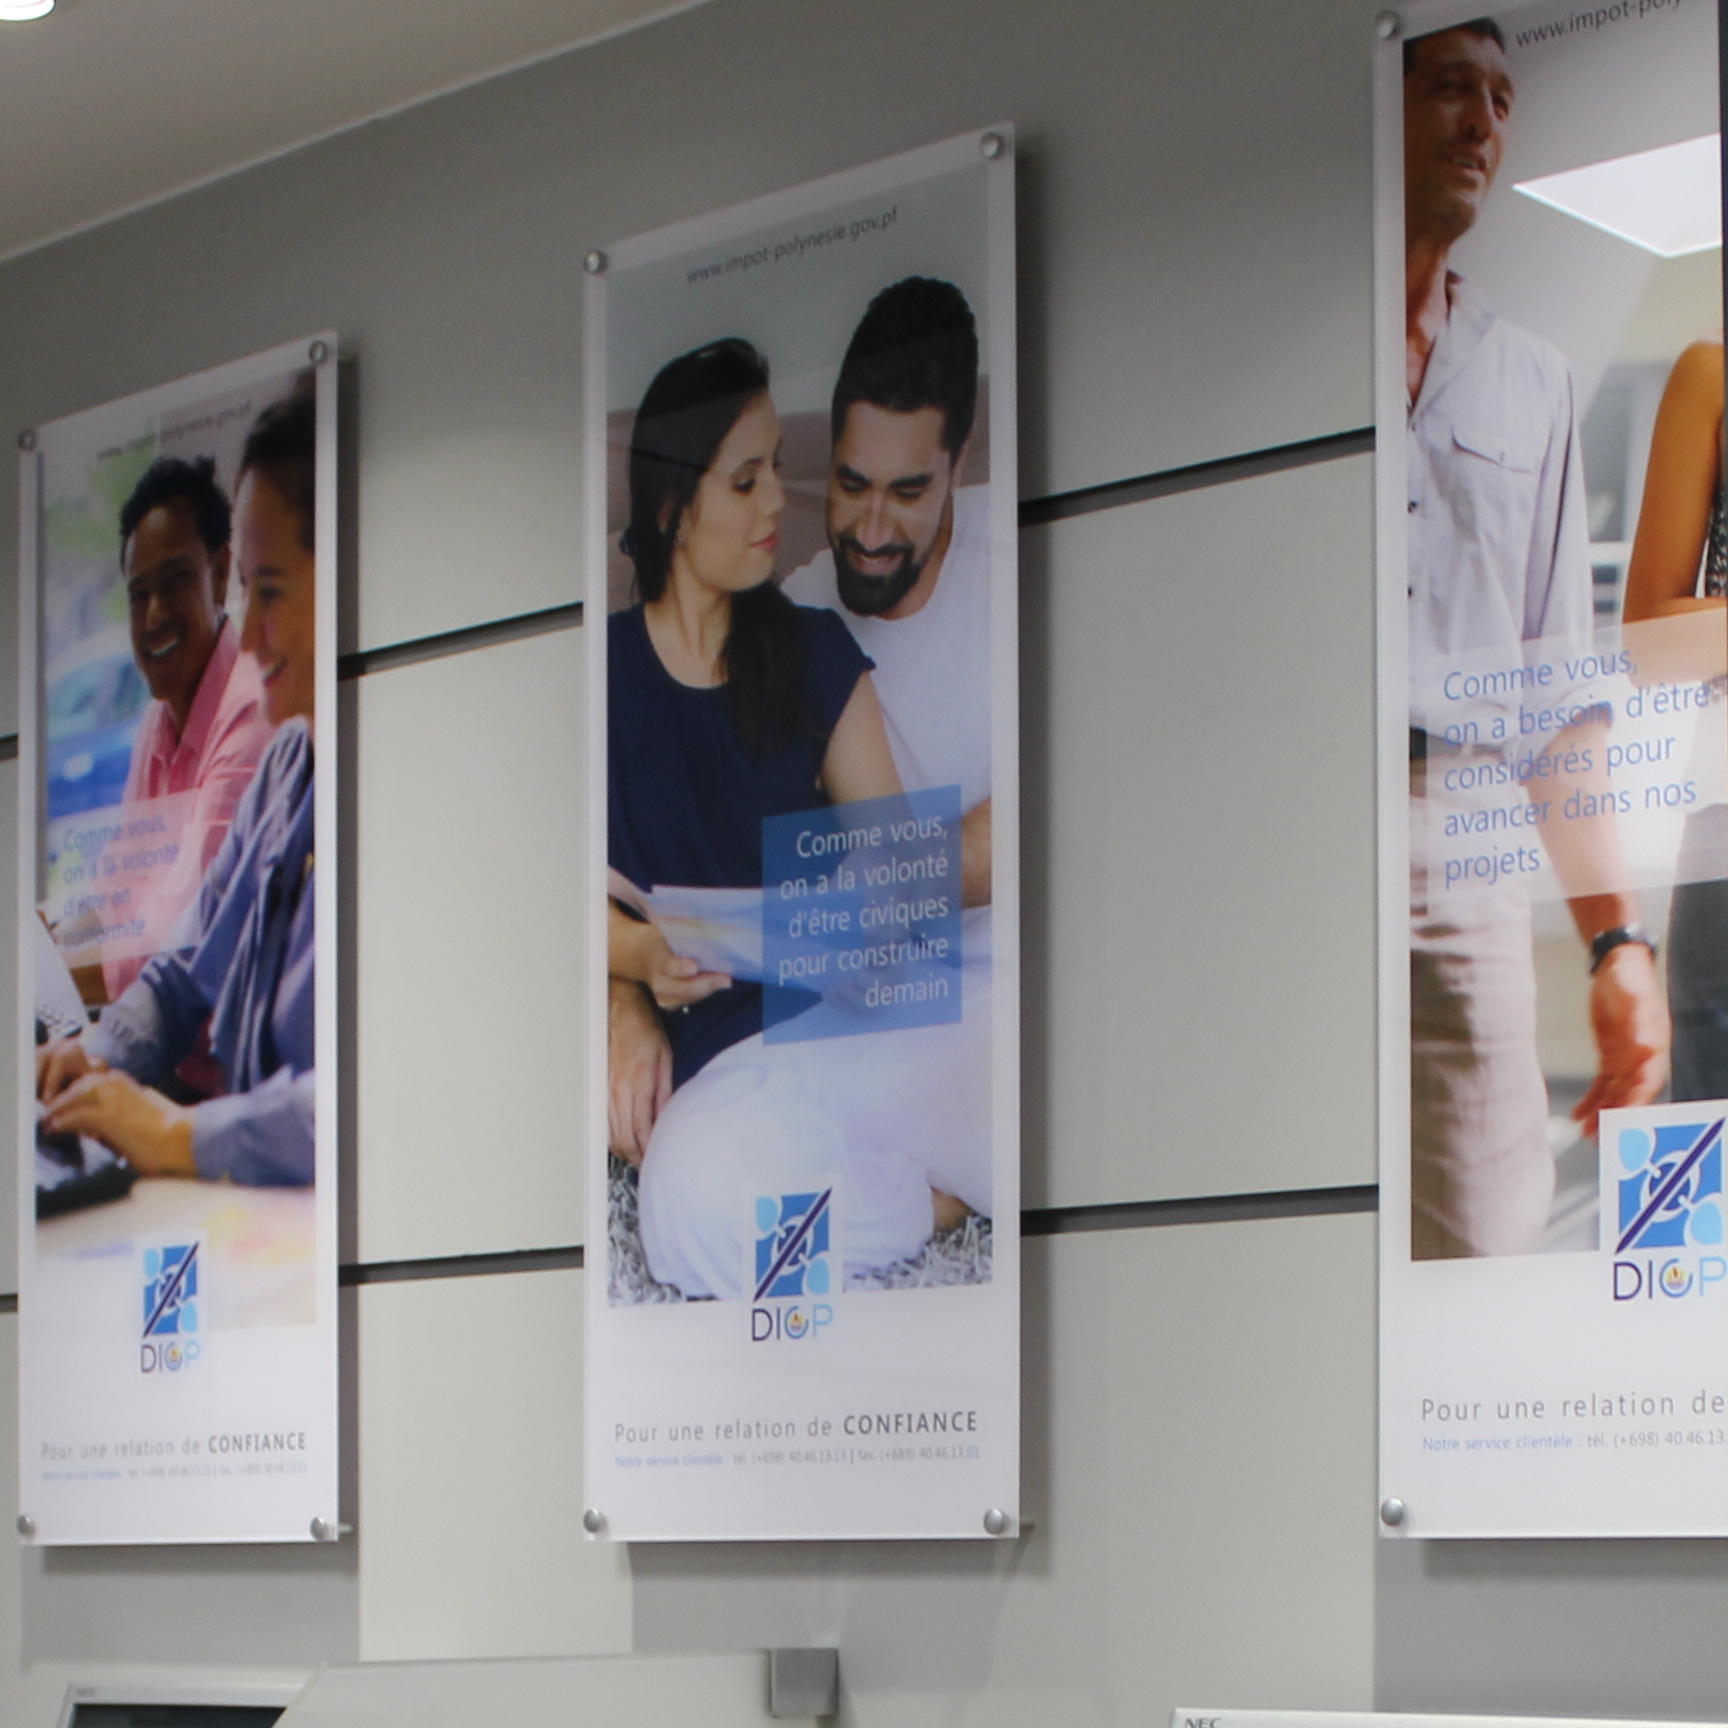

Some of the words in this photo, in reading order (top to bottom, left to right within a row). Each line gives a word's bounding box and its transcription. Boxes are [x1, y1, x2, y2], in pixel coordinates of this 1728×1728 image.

[1443, 663, 1554, 701] Comme
[1564, 650, 1638, 682] vous,
[1443, 720, 1479, 747] on
[1491, 716, 1507, 740] a
[1519, 693, 1614, 735] besoin
[1625, 682, 1712, 719] d'être
[1607, 736, 1677, 777] pour
[1444, 801, 1552, 837] avancer
[1563, 788, 1632, 821] dans
[1644, 780, 1697, 810] nos
[63, 824, 123, 852] Comme
[796, 826, 883, 858] Comme
[889, 815, 949, 843] vous,
[63, 864, 84, 885] on
[102, 853, 117, 877] la
[121, 843, 180, 871] volonté
[779, 877, 809, 900] on
[816, 873, 829, 895] a
[837, 864, 856, 892] la
[864, 849, 949, 887] volonté
[1445, 846, 1542, 891] projets
[111, 888, 131, 908] en
[788, 907, 851, 938] d'être
[859, 896, 949, 930] civiques
[778, 952, 830, 987] pour
[837, 933, 949, 972] construire
[864, 972, 949, 1009] demain
[1613, 1256, 1728, 1301] DICP
[751, 1303, 834, 1342] DICP
[614, 1423, 659, 1443] Pour
[668, 1424, 705, 1442] une
[714, 1418, 797, 1440] relation
[807, 1416, 832, 1437] de
[843, 1410, 978, 1436] CONFIANCE
[1421, 1398, 1482, 1422] Pour
[1497, 1399, 1546, 1420] une
[1562, 1392, 1675, 1418] relation
[1691, 1389, 1726, 1416] de
[40, 1441, 73, 1461] Pour
[80, 1443, 107, 1460] une
[113, 1439, 174, 1459] relation
[181, 1437, 200, 1455] de
[207, 1430, 307, 1455] CONFIANCE
[1422, 1436, 1461, 1451] Notre
[1465, 1436, 1511, 1450] service
[1516, 1433, 1573, 1449] clientèle
